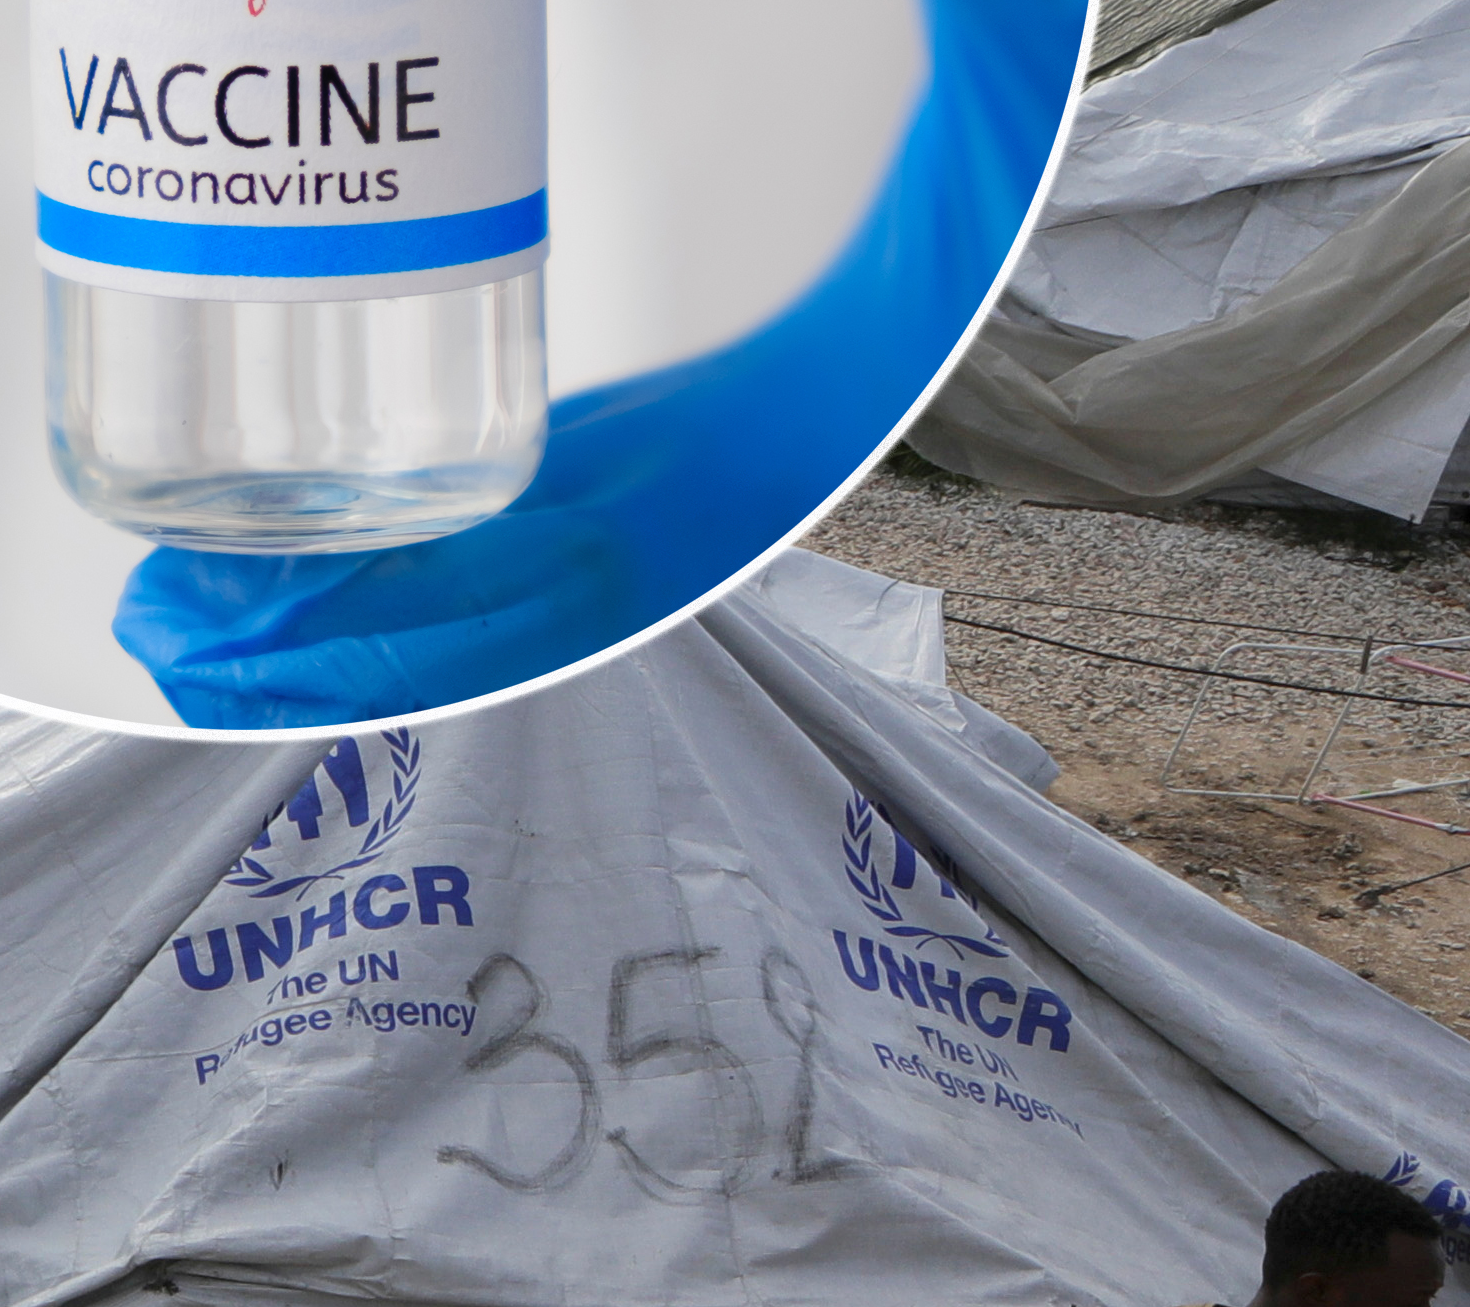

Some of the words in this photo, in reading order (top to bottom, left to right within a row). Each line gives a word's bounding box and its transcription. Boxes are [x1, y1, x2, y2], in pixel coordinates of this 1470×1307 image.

[58, 46, 442, 150] VACCINE
[86, 157, 401, 206] coronavirus
[171, 865, 474, 991] UNHCR
[266, 971, 328, 1005] The
[338, 950, 400, 986] UN
[832, 929, 1073, 1054] UNHCR
[194, 1009, 333, 1087] Refugee
[345, 997, 477, 1037] Agency
[872, 1042, 986, 1104] Refugee
[916, 1025, 975, 1065] The
[974, 1043, 1019, 1082] UN
